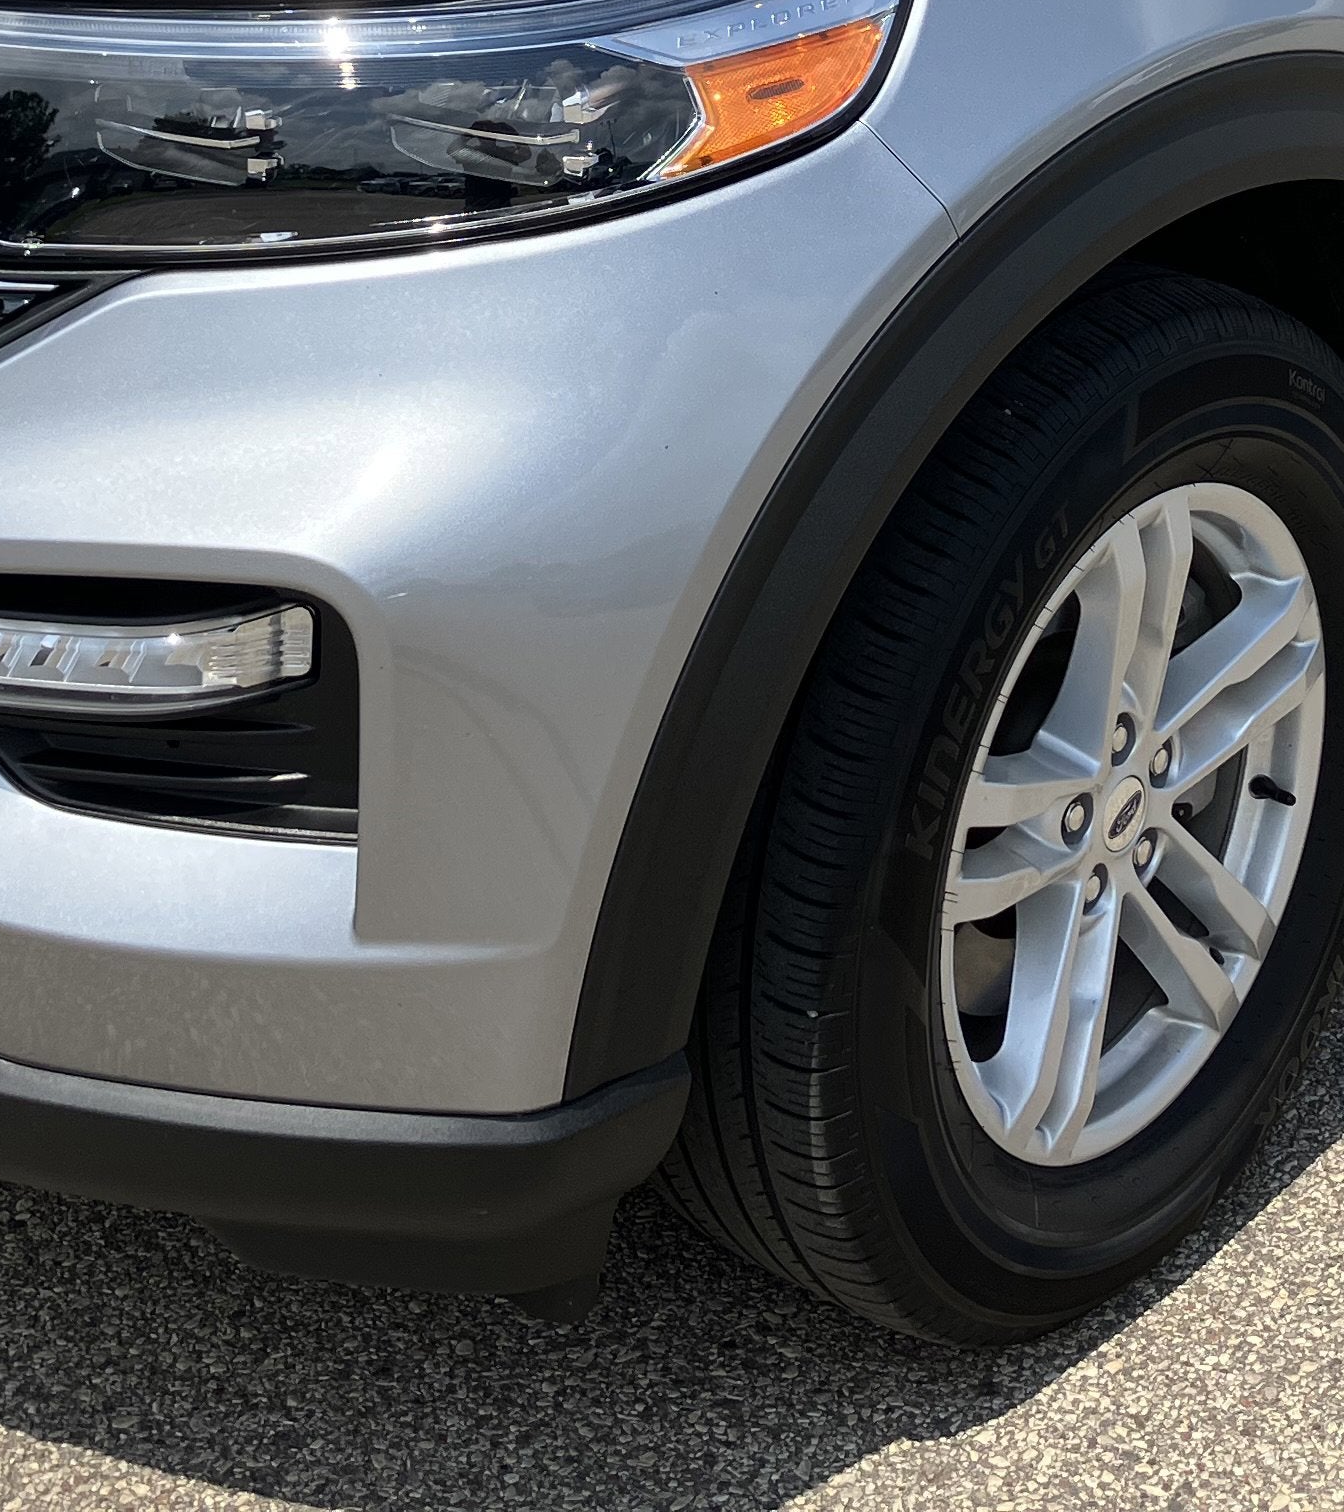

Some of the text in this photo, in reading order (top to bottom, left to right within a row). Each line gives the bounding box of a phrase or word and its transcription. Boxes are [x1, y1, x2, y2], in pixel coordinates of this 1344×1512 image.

[1288, 368, 1325, 404] Kontrol
[906, 500, 1068, 861] KINERGY GT
